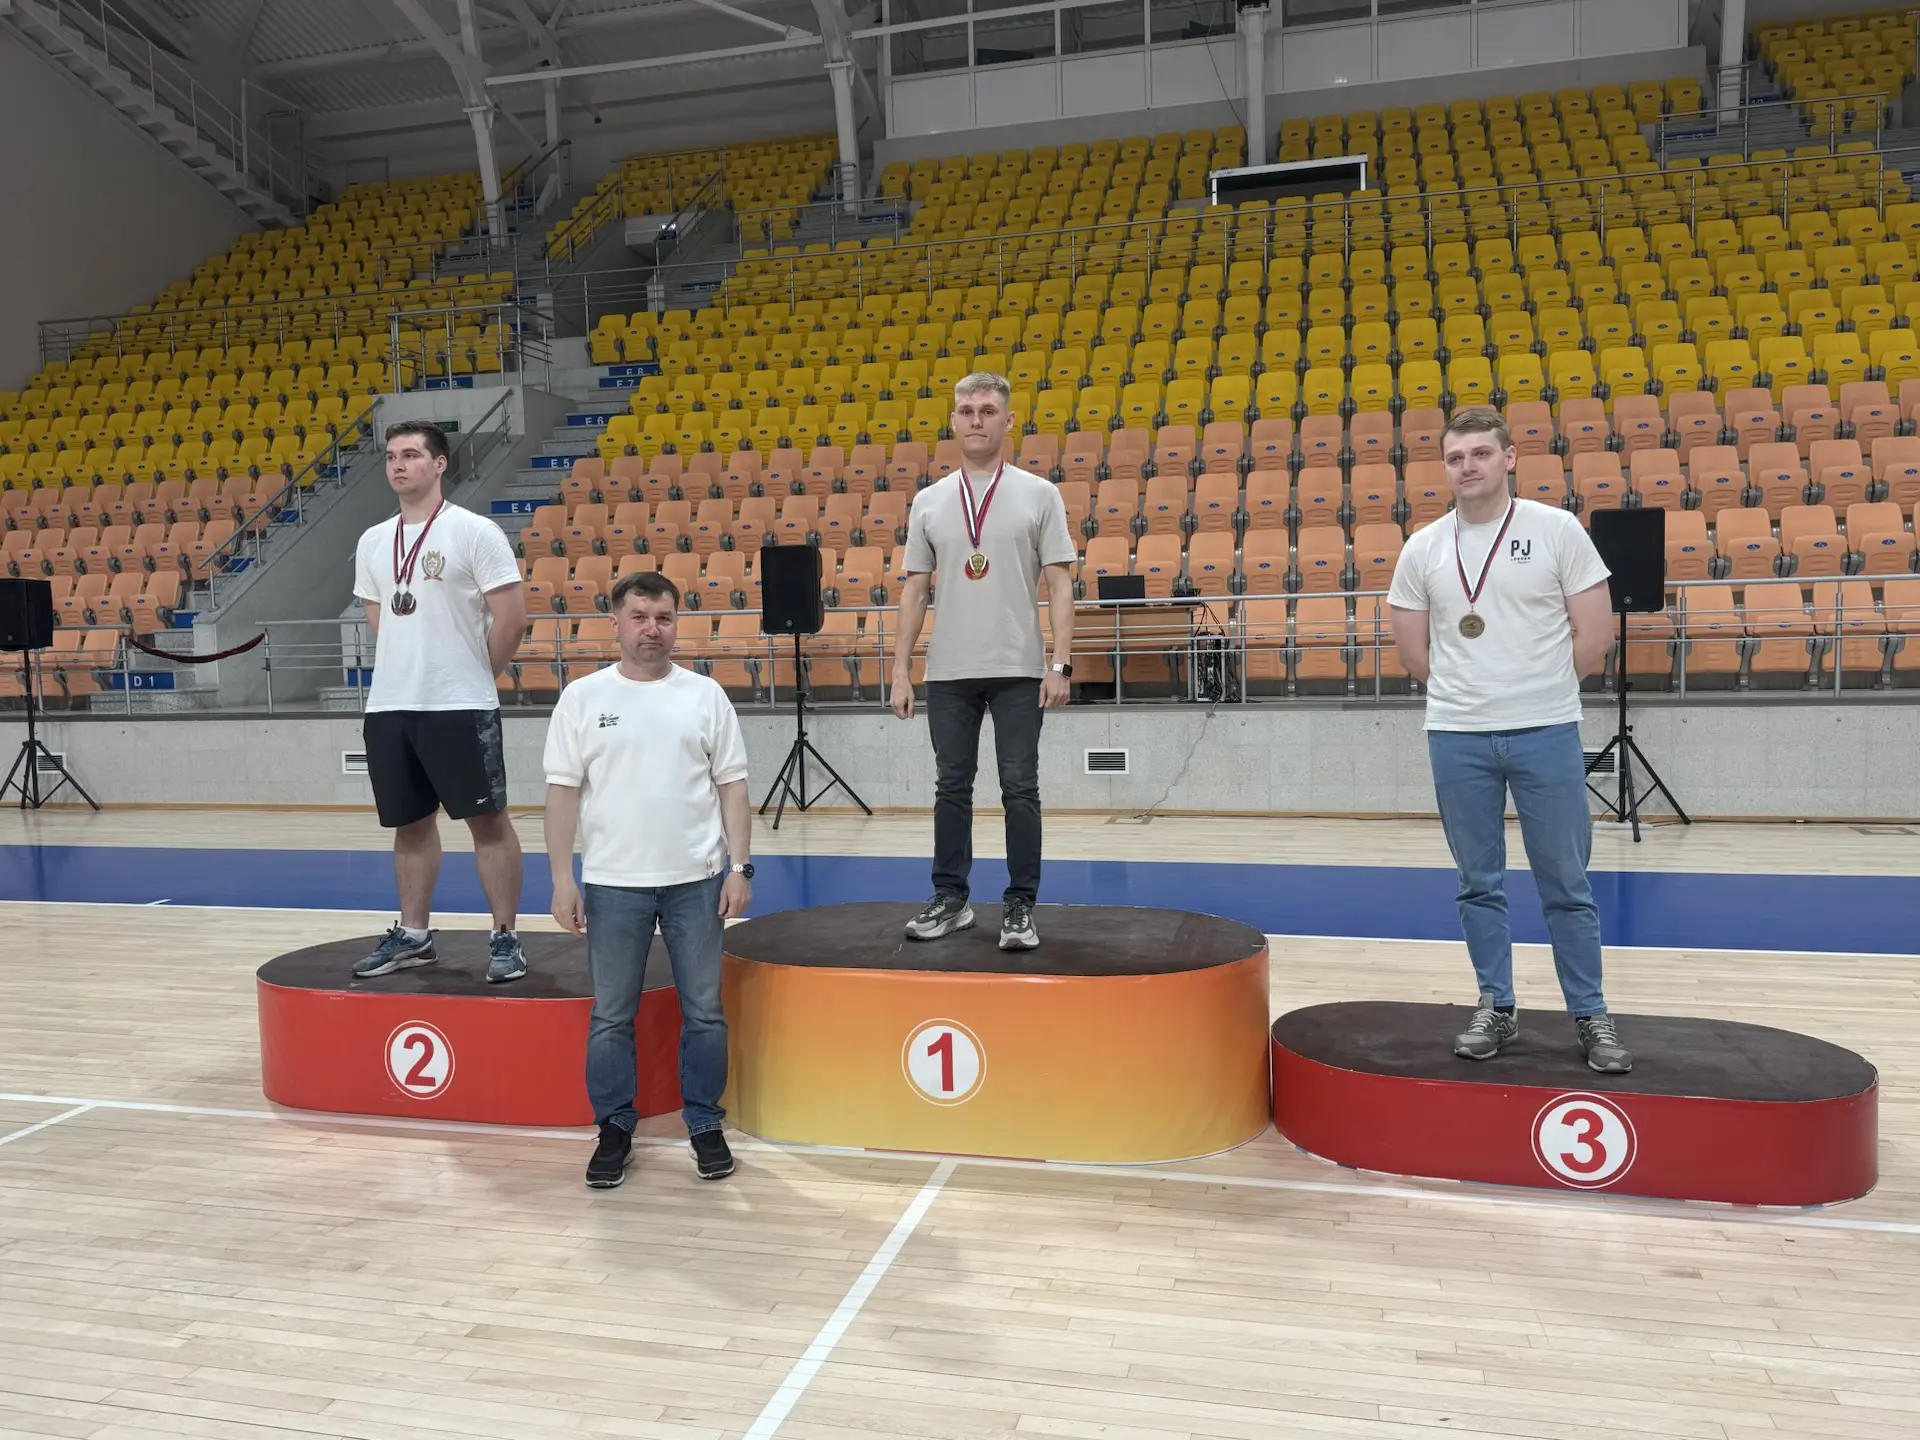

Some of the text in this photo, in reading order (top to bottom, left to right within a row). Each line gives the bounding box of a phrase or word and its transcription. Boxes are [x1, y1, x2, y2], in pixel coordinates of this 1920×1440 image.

[551, 457, 571, 468] E 5
[511, 503, 532, 513] E 4
[1510, 539, 1531, 557] PJ
[134, 676, 154, 687] D 1
[403, 1033, 436, 1087] 2
[927, 1032, 954, 1092] 1
[1560, 1108, 1607, 1174] 3
